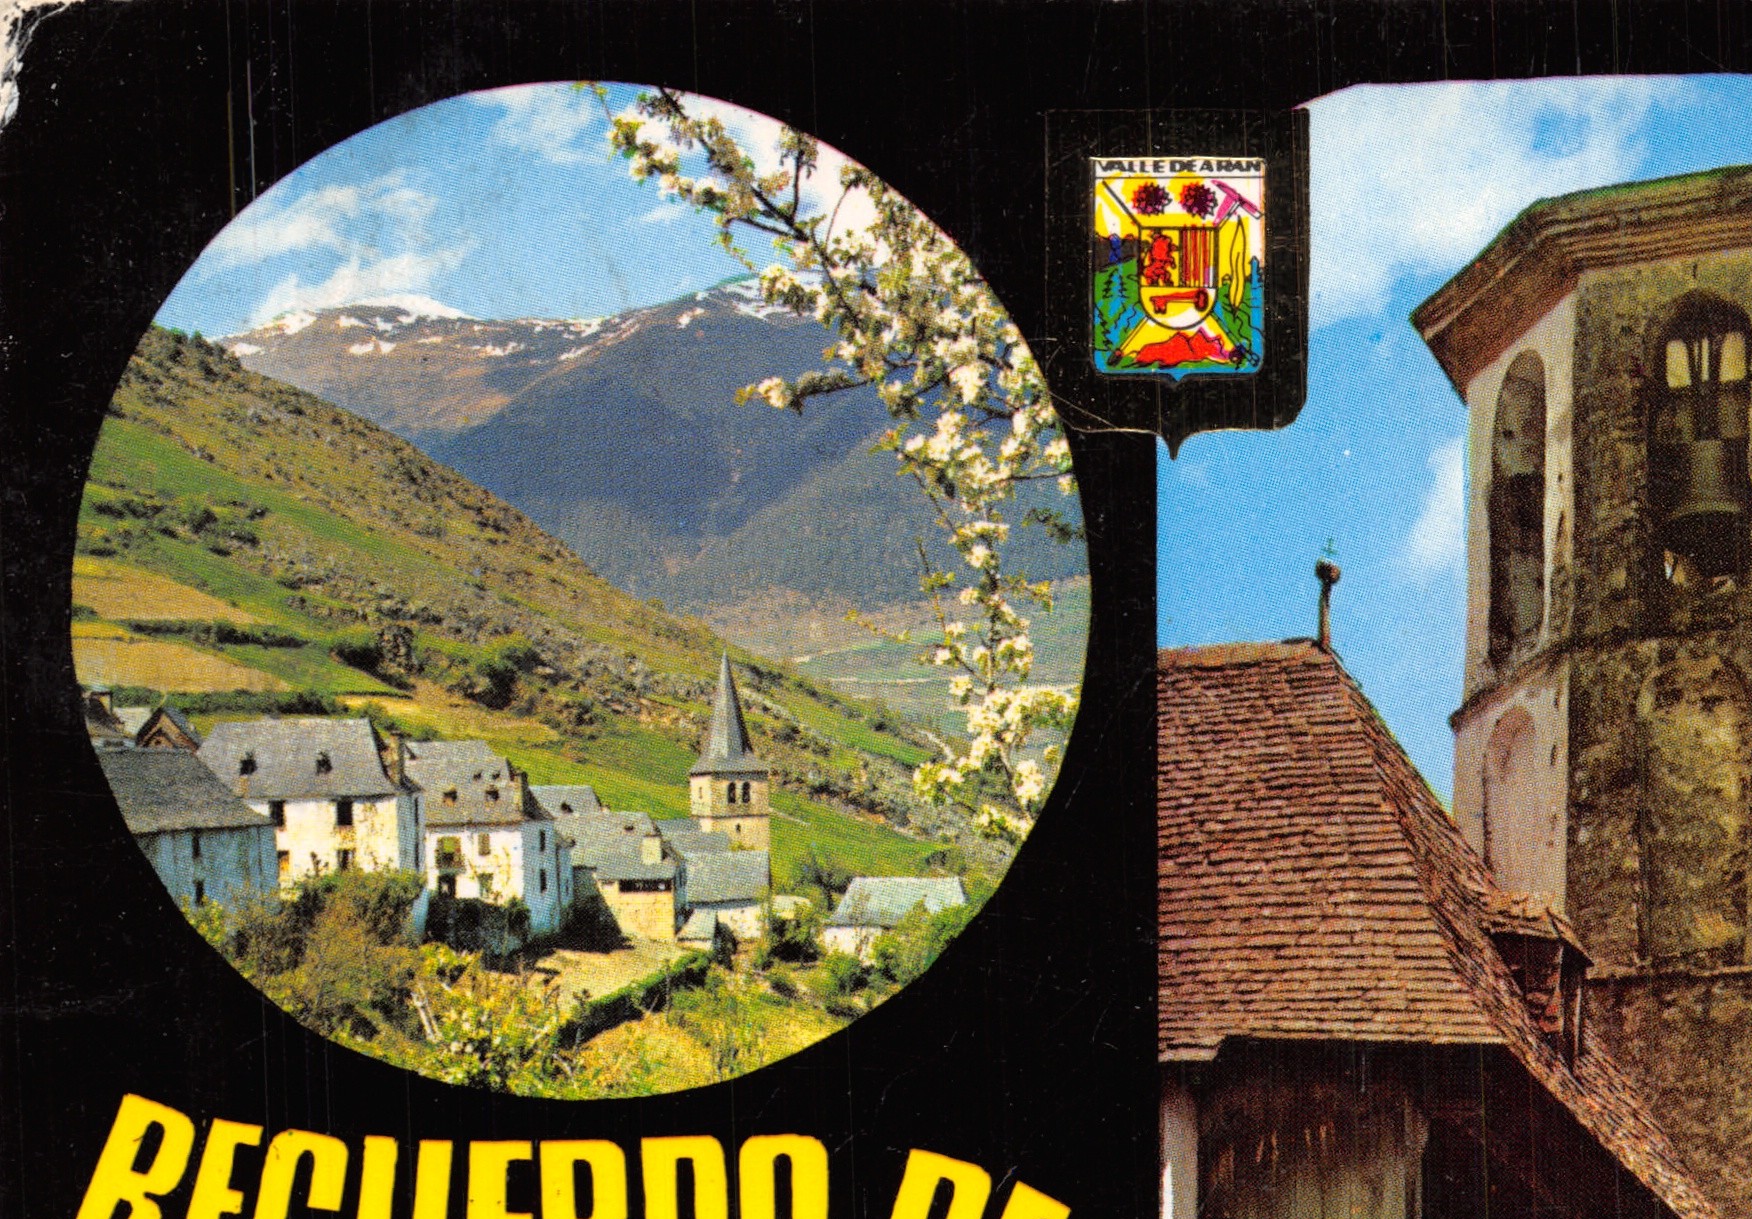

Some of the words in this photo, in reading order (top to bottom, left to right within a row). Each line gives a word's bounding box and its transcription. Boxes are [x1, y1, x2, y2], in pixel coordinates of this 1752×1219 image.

[1100, 159, 1165, 173] VALLE
[1169, 159, 1197, 173] DE
[1198, 159, 1261, 173] ARAN
